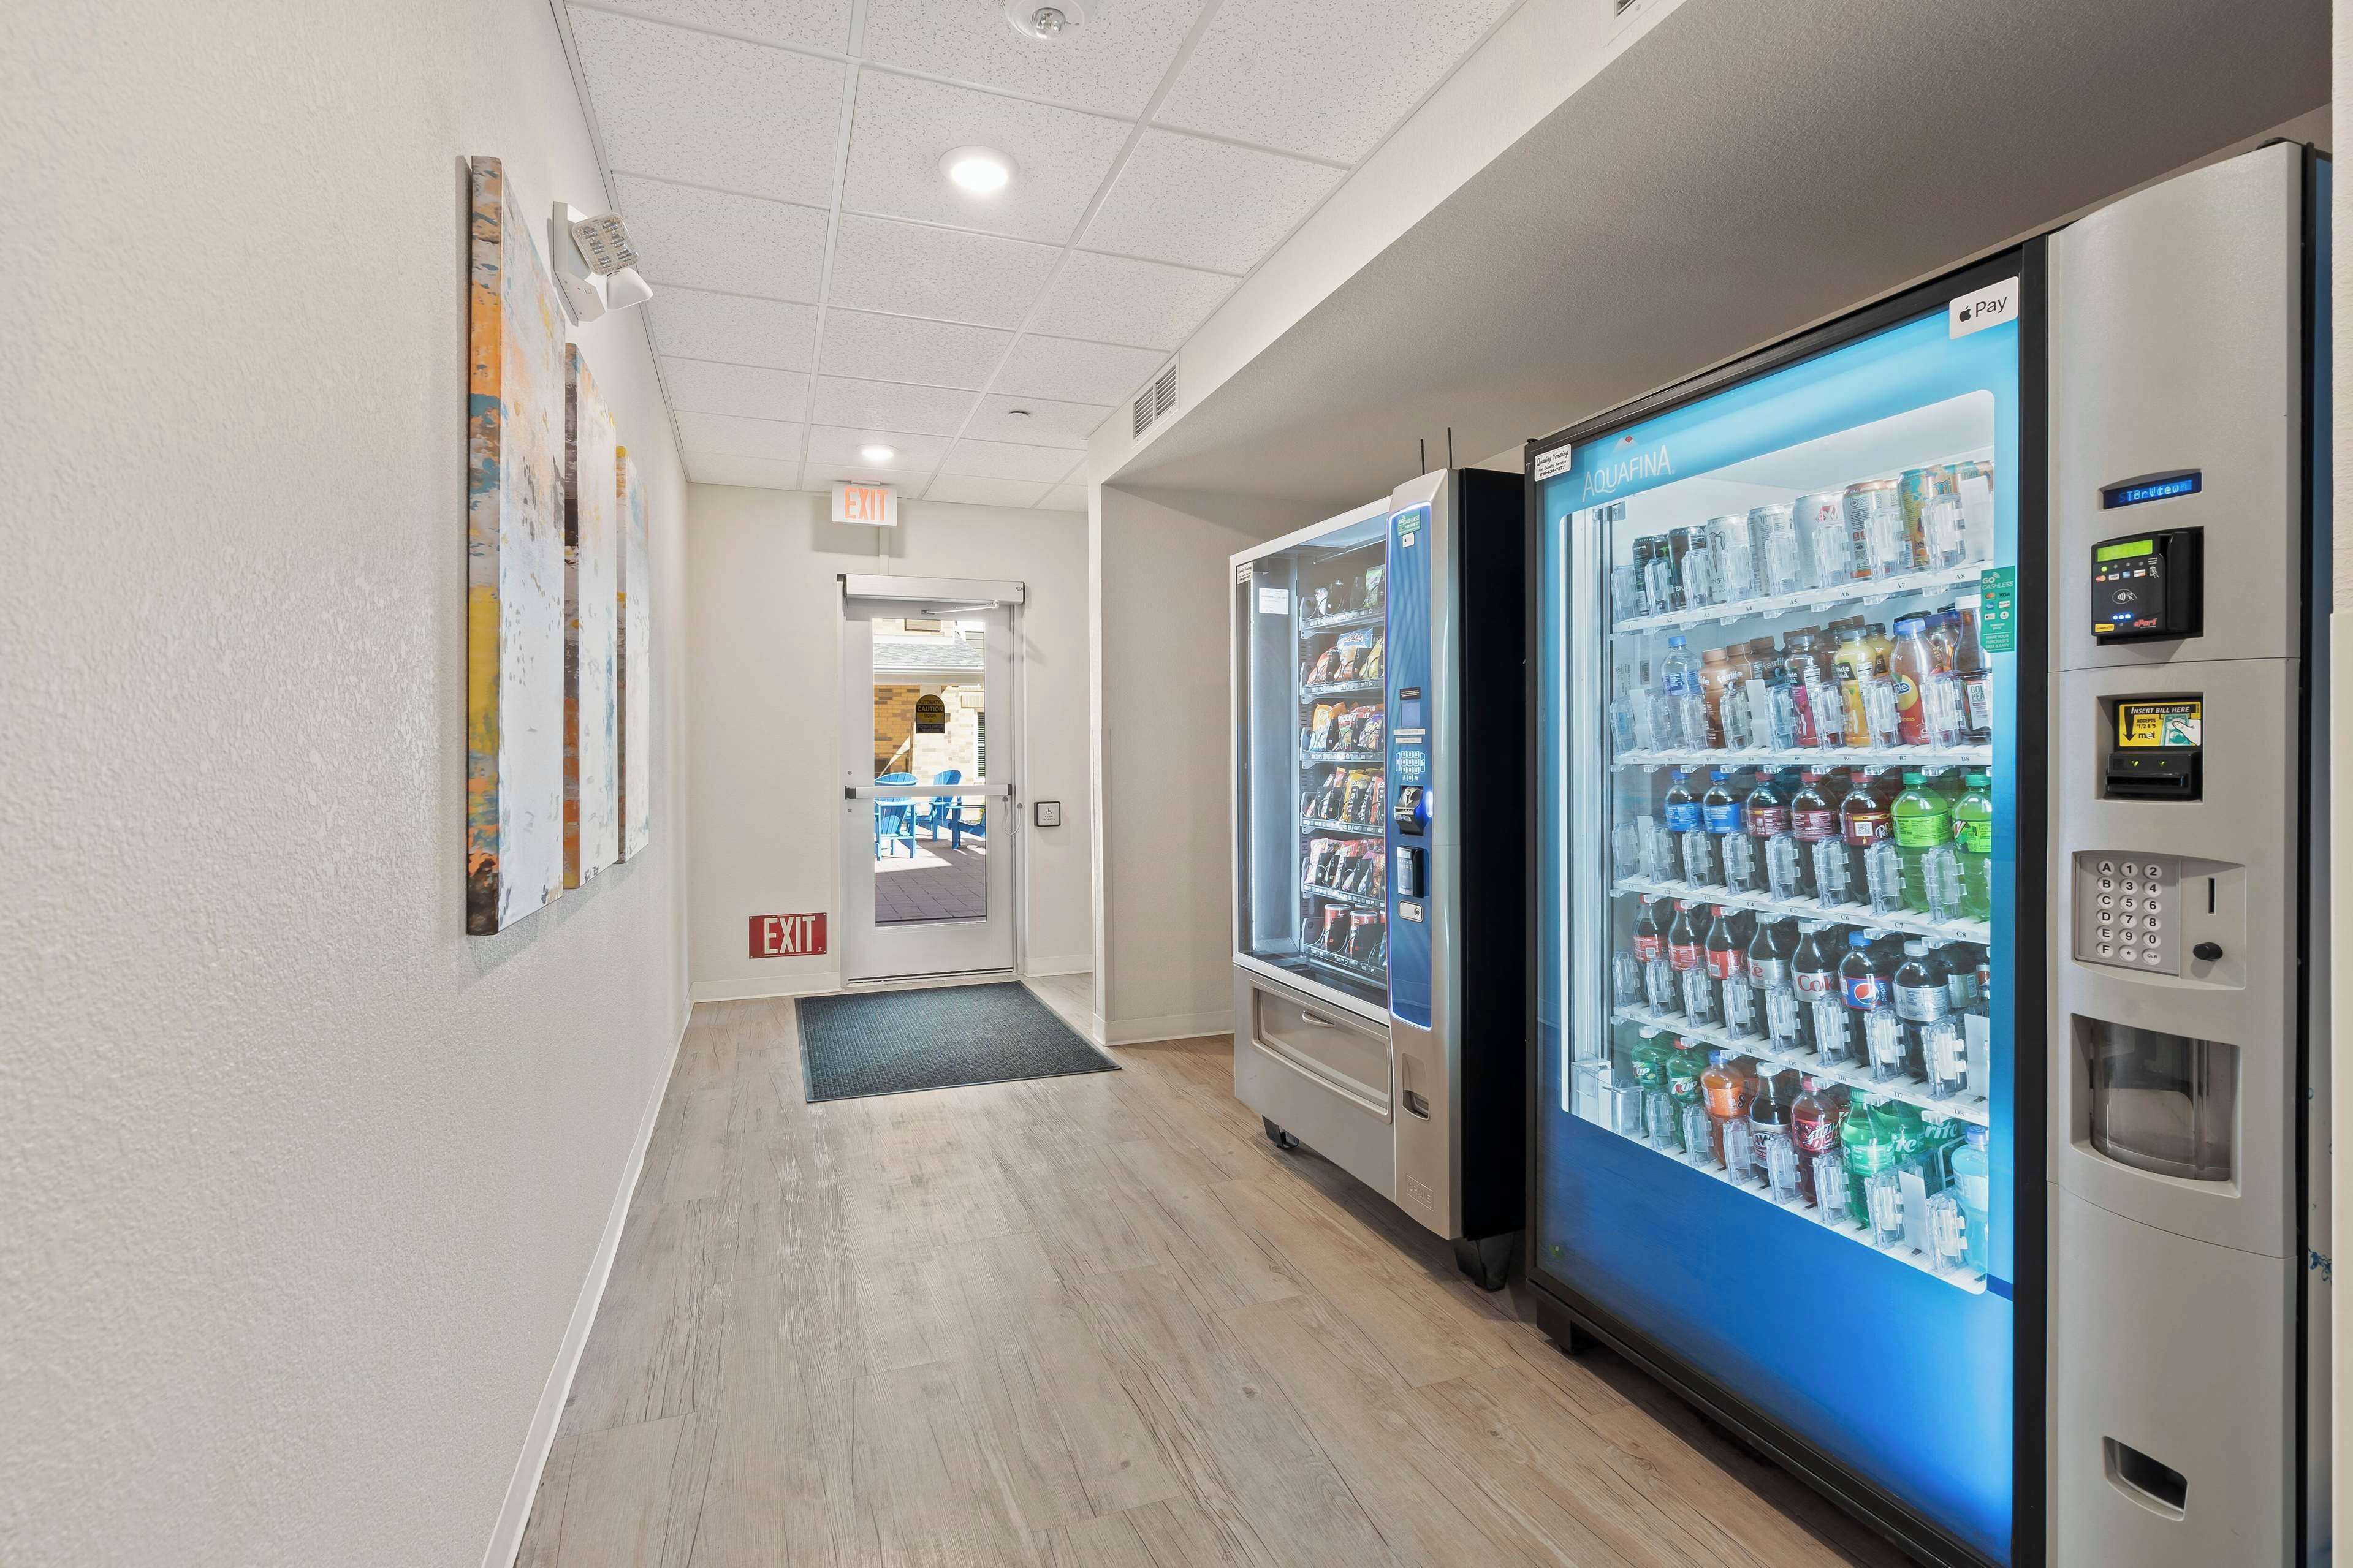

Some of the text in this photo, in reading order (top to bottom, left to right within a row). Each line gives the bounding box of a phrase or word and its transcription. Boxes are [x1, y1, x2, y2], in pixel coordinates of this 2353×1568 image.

[1975, 296, 2008, 317] Pay
[1537, 450, 1568, 466] Quality Vending
[1582, 444, 1672, 502] AQUAFINA
[845, 487, 888, 521] EXIT
[1982, 581, 2014, 590] CASHLESS
[1895, 683, 1909, 694] ole
[1971, 685, 1985, 694] GOL
[2138, 731, 2156, 740] mei
[2102, 863, 2157, 876] A 1 2
[2102, 879, 2157, 893] B 3 4
[2102, 896, 2157, 910] C 5 6
[2102, 912, 2156, 927] D 7 8
[764, 915, 815, 955] EXIT
[2102, 928, 2156, 944] E 9 0
[2102, 945, 2110, 953] F
[1797, 975, 1834, 992] Cok
[1878, 983, 1887, 1002] pepsi
[1924, 1121, 1958, 1140] rite
